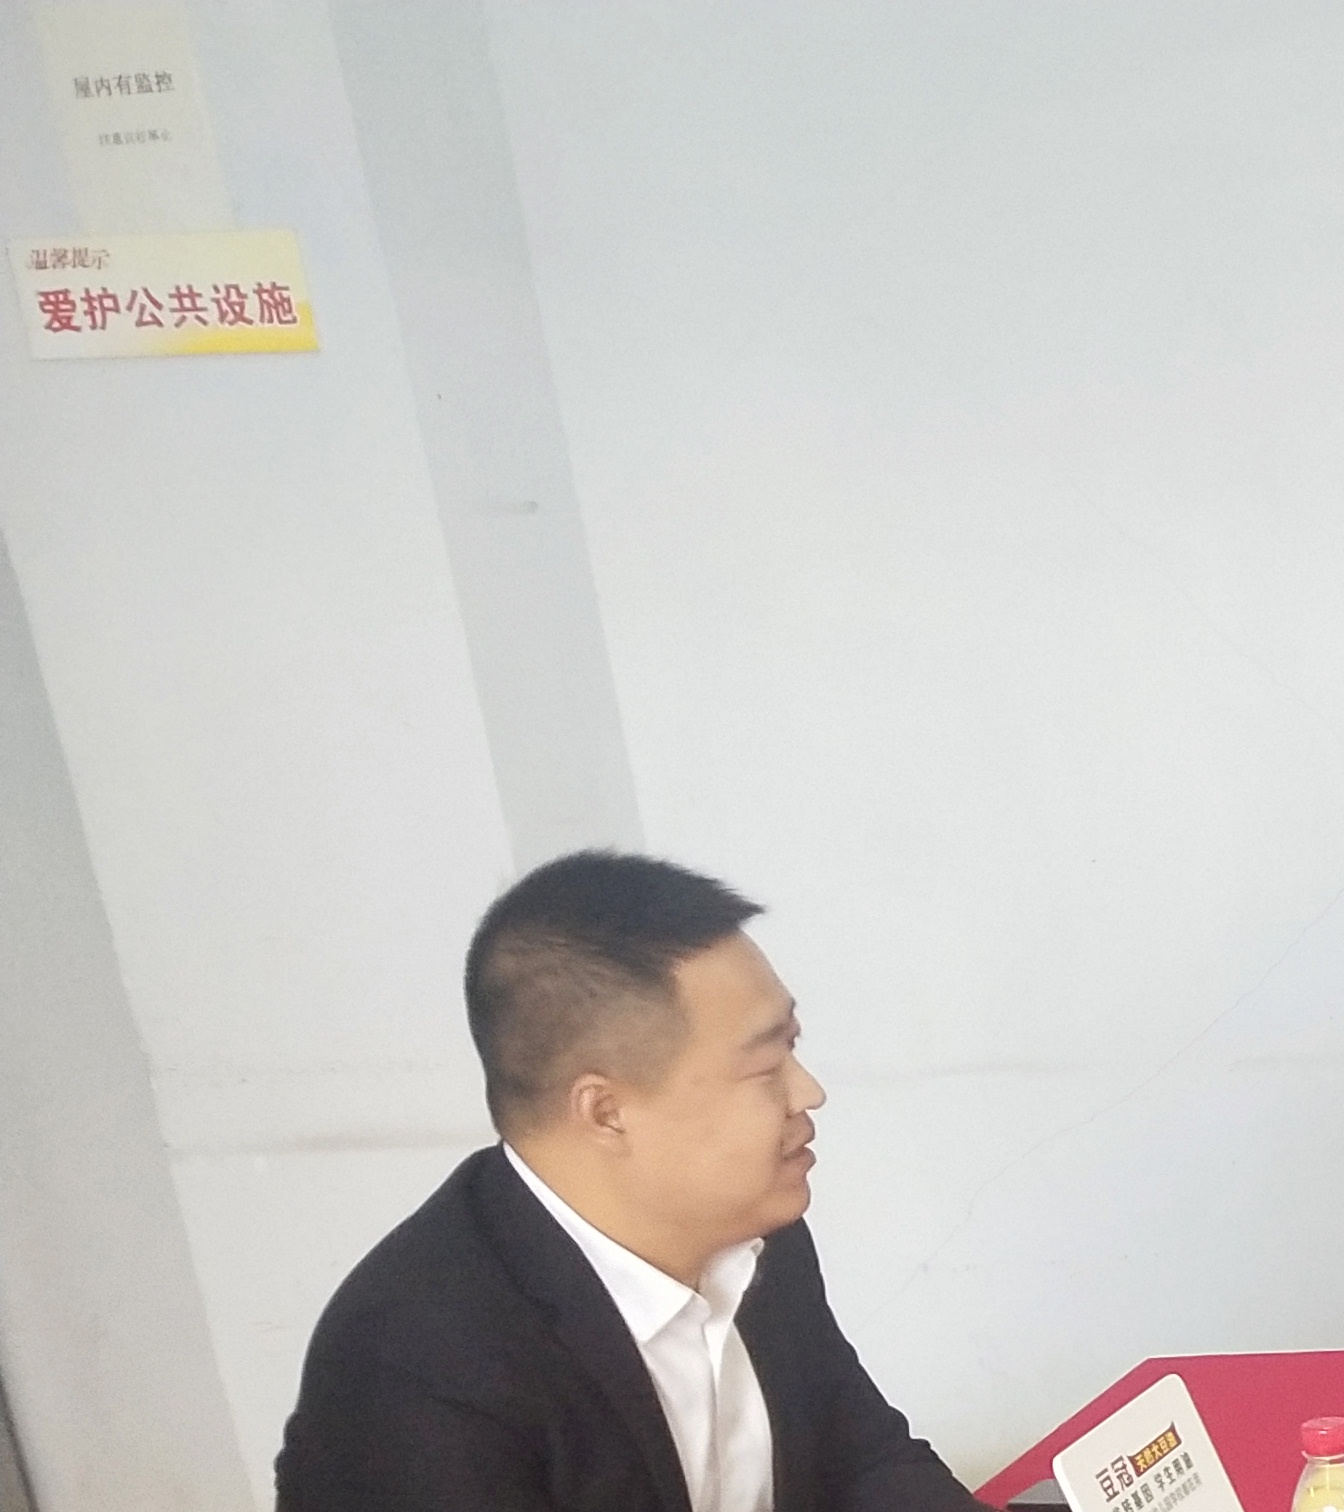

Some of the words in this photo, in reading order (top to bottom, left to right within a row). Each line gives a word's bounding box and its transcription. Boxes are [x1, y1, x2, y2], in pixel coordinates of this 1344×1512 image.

[74, 71, 175, 98] 屋内有监控
[29, 247, 110, 270] 温馨提示
[37, 281, 298, 333] 爱护公共设施
[1095, 1454, 1135, 1503] 豆冠
